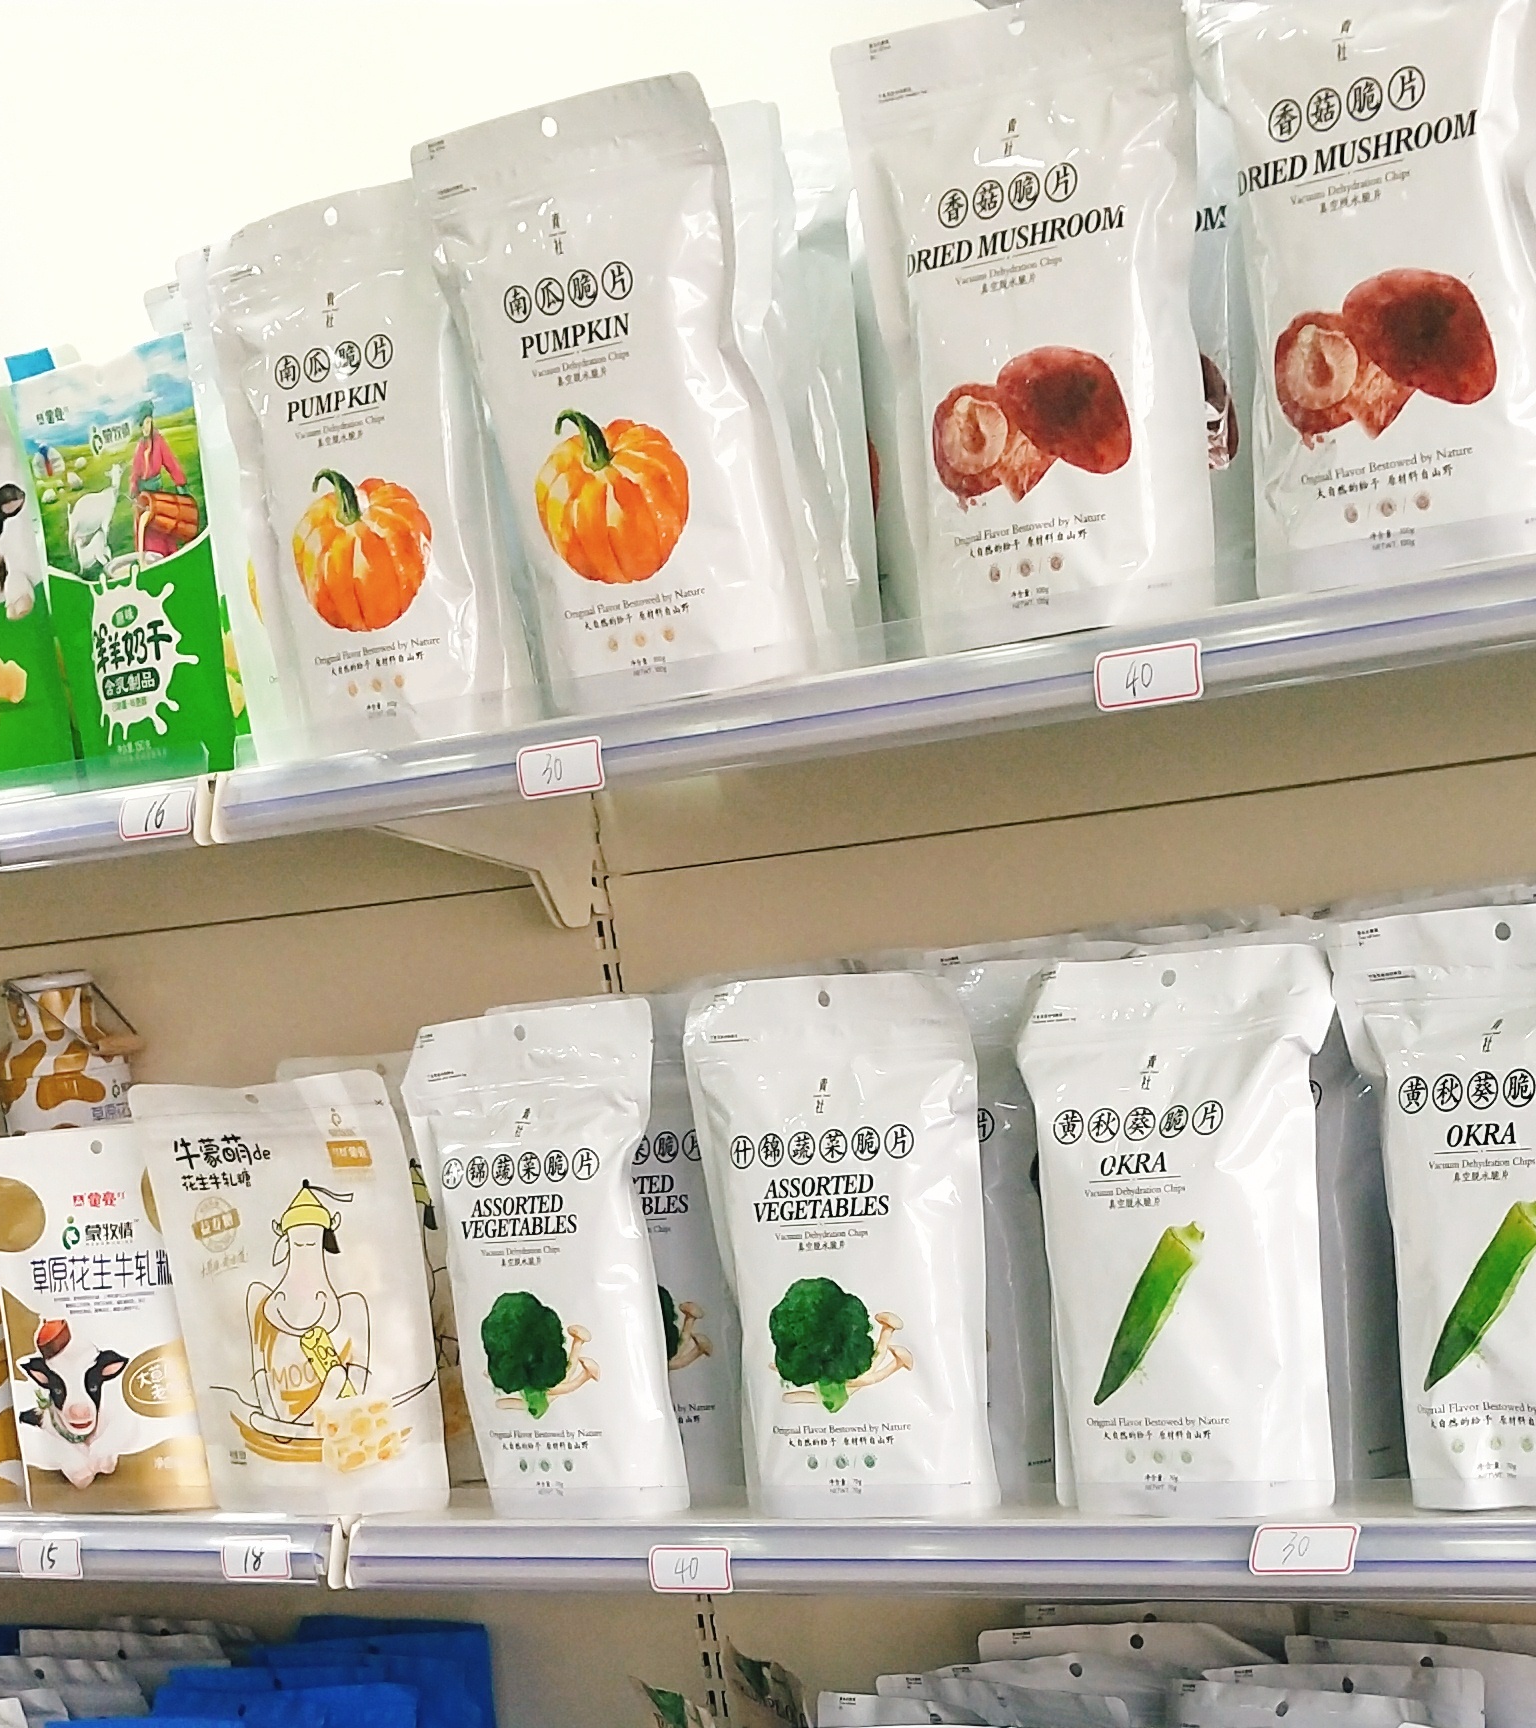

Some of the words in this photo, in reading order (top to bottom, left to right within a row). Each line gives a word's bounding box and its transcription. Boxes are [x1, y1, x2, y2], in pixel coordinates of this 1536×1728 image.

[1268, 65, 1426, 143] 香菇脆片
[1237, 154, 1308, 199] DRIED
[1314, 109, 1479, 173] MUSHROOM
[938, 161, 1079, 230] 香菇脆片
[907, 232, 975, 279] DRIED
[977, 205, 1126, 265] MUSHROOM
[503, 260, 634, 324] 南瓜脆片
[519, 312, 631, 360] PUMPKIN
[274, 333, 394, 391] 南瓜脆片
[286, 380, 389, 423] PUMPKIN
[104, 671, 156, 698] 含乳制品
[1125, 660, 1154, 697] 40
[144, 793, 171, 832] 16
[1052, 1099, 1224, 1144] 黄秋葵脆片
[1445, 1121, 1517, 1149] OKRA
[174, 1134, 271, 1170] 牛蒙萌de
[730, 1124, 914, 1169] 什锦蔬菜脆片
[1099, 1150, 1167, 1178] OKRA
[1511, 1155, 1536, 1169] Chips
[181, 1168, 251, 1192] 花生牛轧糖
[764, 1174, 874, 1199] ASSORTED
[471, 1194, 563, 1218] ASSORTED
[754, 1195, 889, 1223] VEGETABLES
[85, 1222, 133, 1241] 蒙牧情
[461, 1214, 578, 1240] VEGETABLES
[1184, 1415, 1196, 1428] by
[1198, 1415, 1230, 1426] Nature
[41, 1543, 58, 1571] 15
[244, 1545, 265, 1574] 18
[674, 1556, 699, 1584] 40
